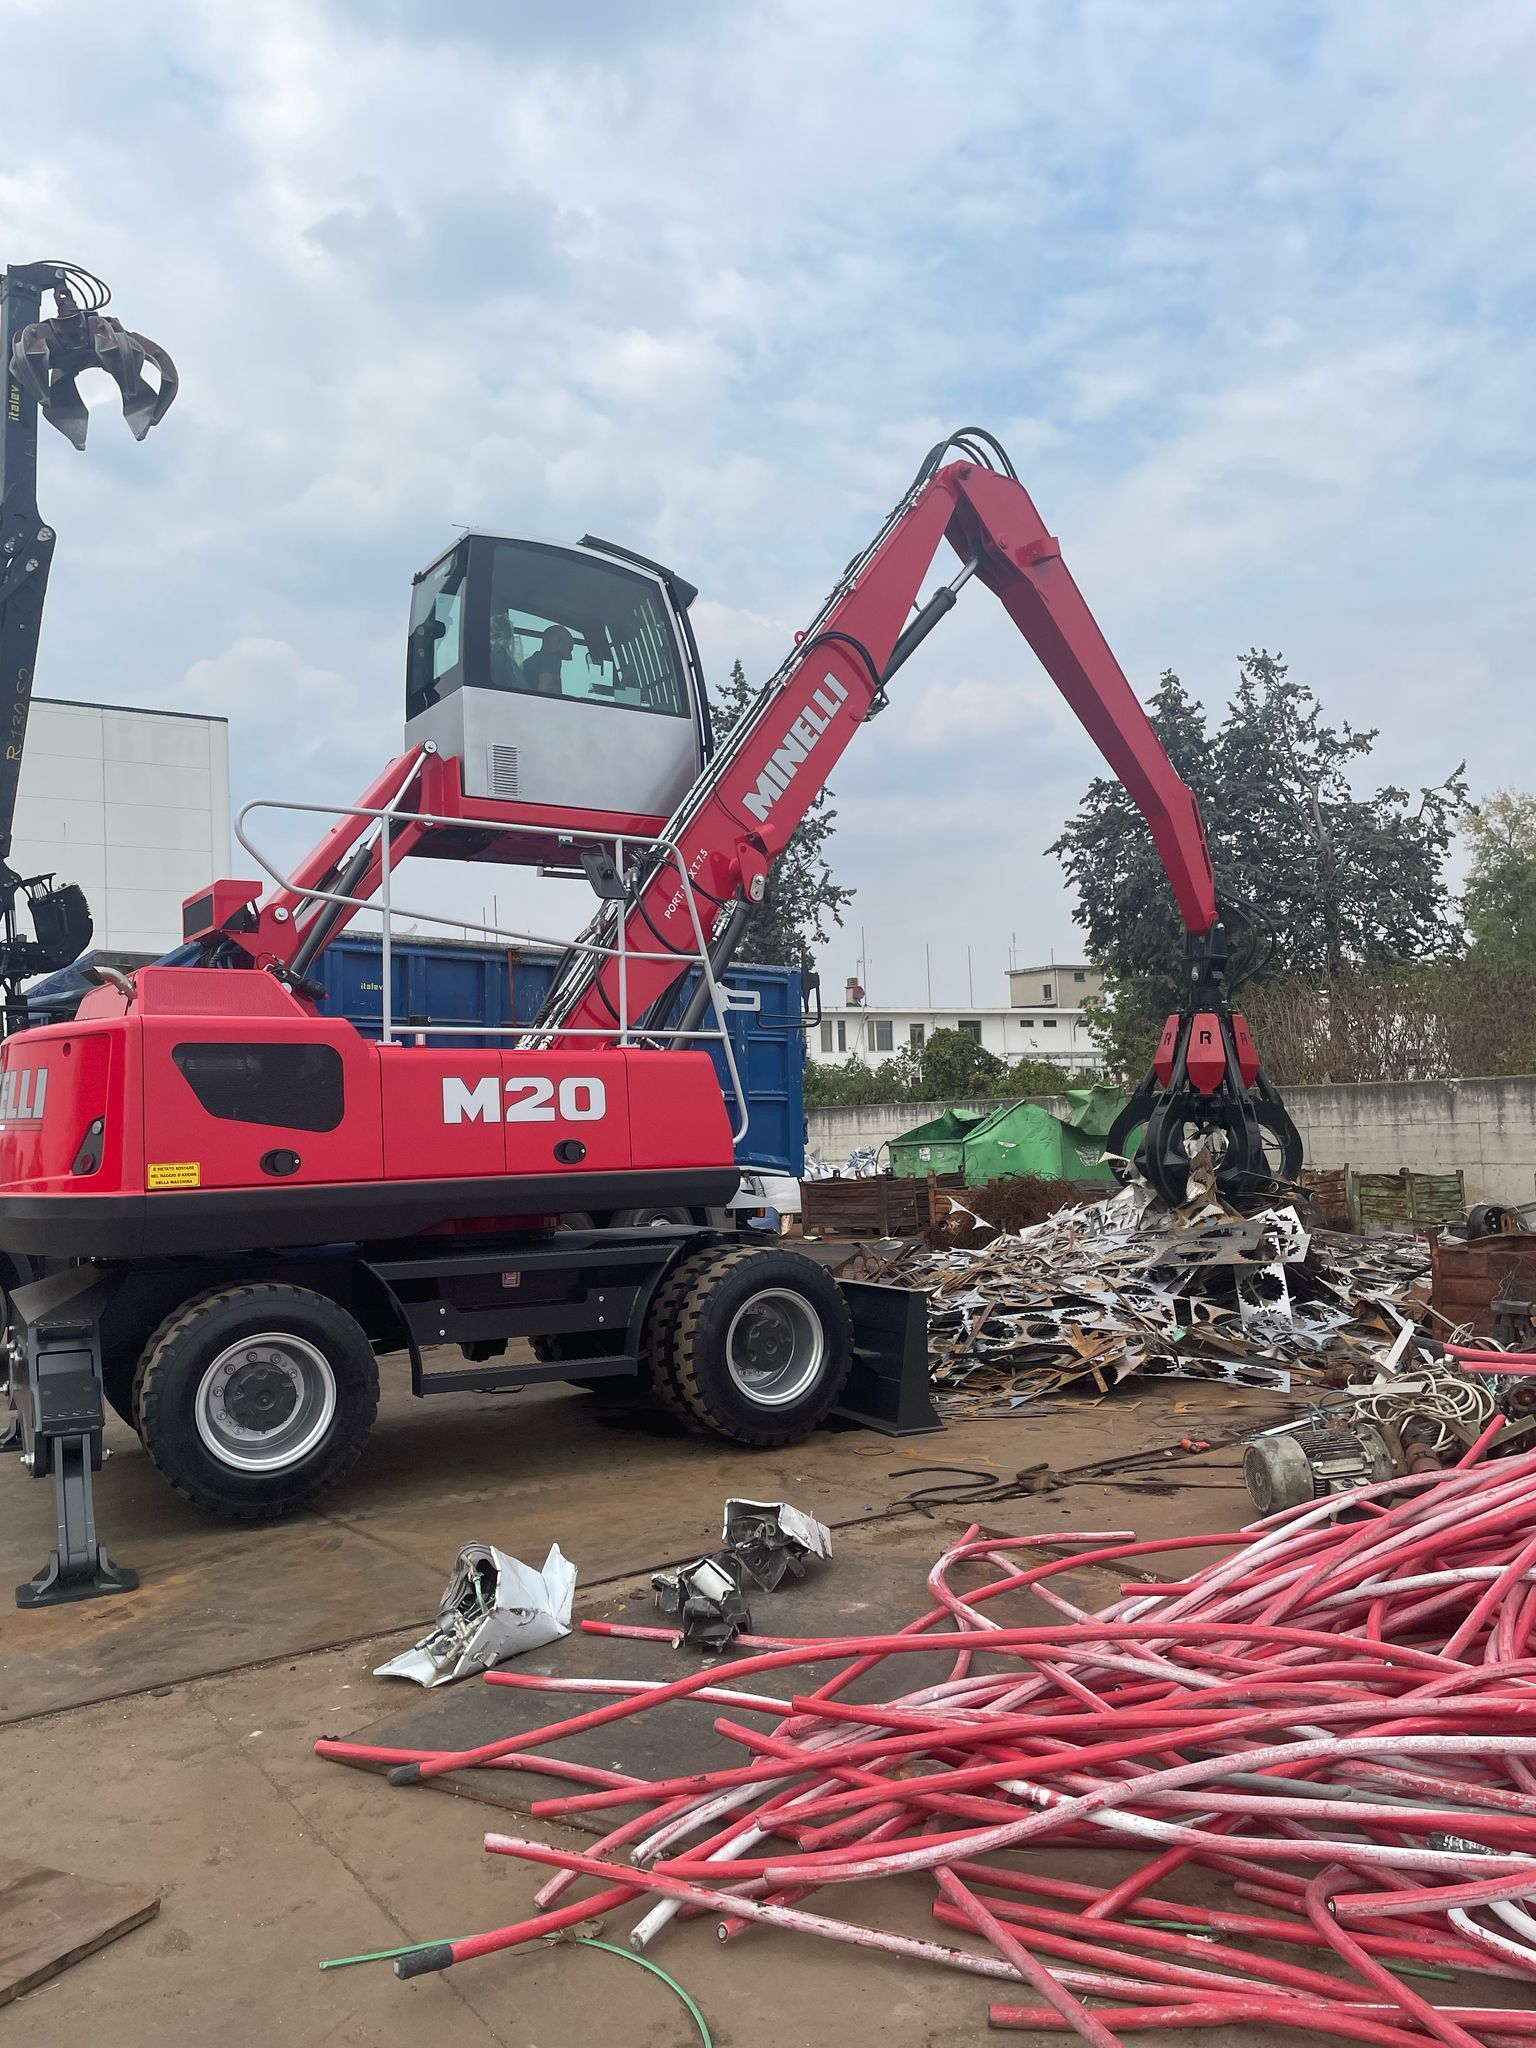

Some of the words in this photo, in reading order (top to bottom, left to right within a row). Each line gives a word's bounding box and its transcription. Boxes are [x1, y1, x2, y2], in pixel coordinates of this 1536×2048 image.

[742, 672, 849, 823] MINELLI
[1200, 1030, 1212, 1045] R
[0, 1067, 48, 1119] ELLI
[442, 1077, 606, 1124] M20
